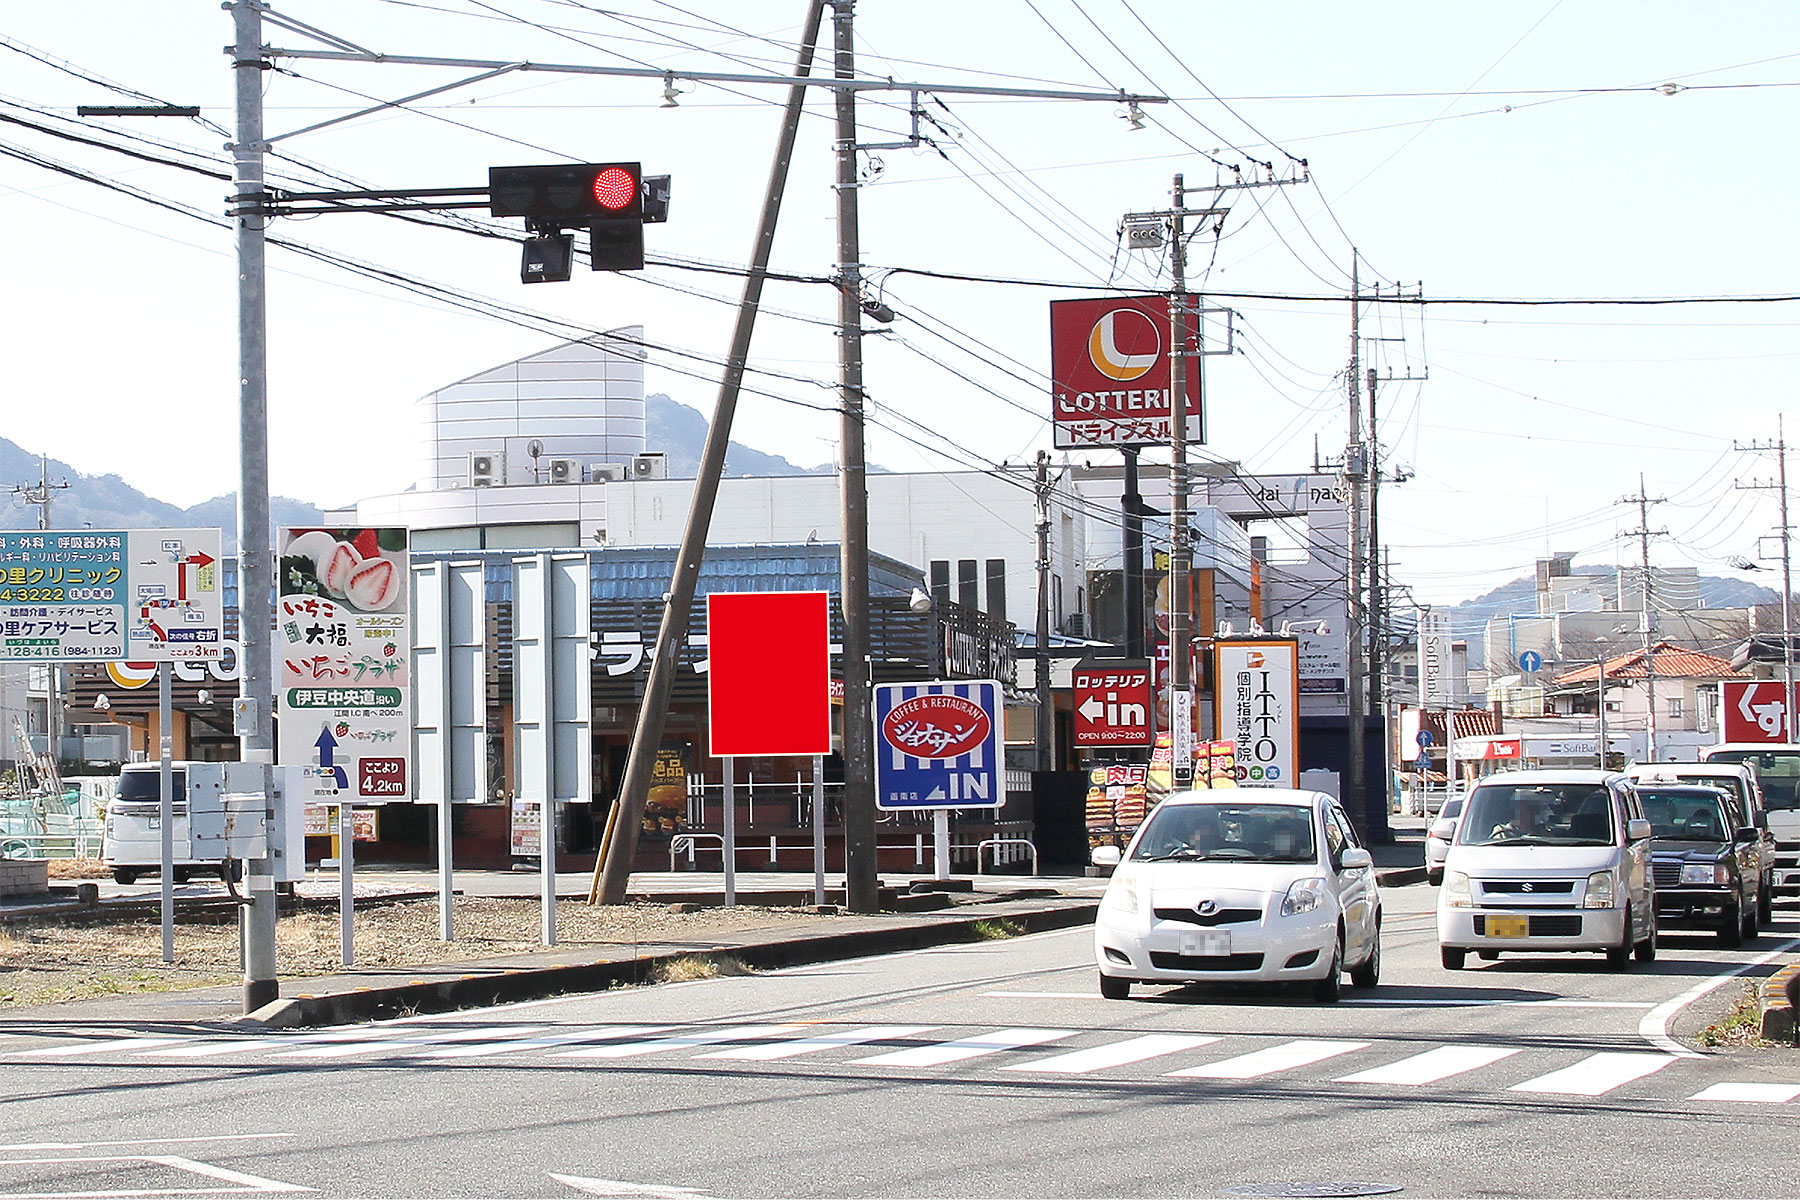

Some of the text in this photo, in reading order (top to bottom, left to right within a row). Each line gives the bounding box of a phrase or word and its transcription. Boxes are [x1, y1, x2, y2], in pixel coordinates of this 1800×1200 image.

[1071, 421, 1189, 443] ドライブスル
[283, 599, 336, 617] いちご
[0, 619, 118, 636] 里ケアサービス
[306, 622, 348, 646] 大福
[1426, 636, 1440, 698] SoftBank
[1076, 675, 1146, 689] ロッテリア
[295, 689, 395, 706] 伊豆中央道沿い
[889, 698, 984, 723] COFFEE & RESTAURANT
[1107, 692, 1146, 727] in
[1236, 671, 1252, 762] 個別指導学院
[1254, 671, 1277, 762] ITTO
[893, 720, 979, 756] ジョナサン
[1078, 732, 1100, 740] OPEN
[366, 762, 399, 773] ここより
[362, 775, 403, 793] 4.2km
[949, 772, 989, 800] IN
